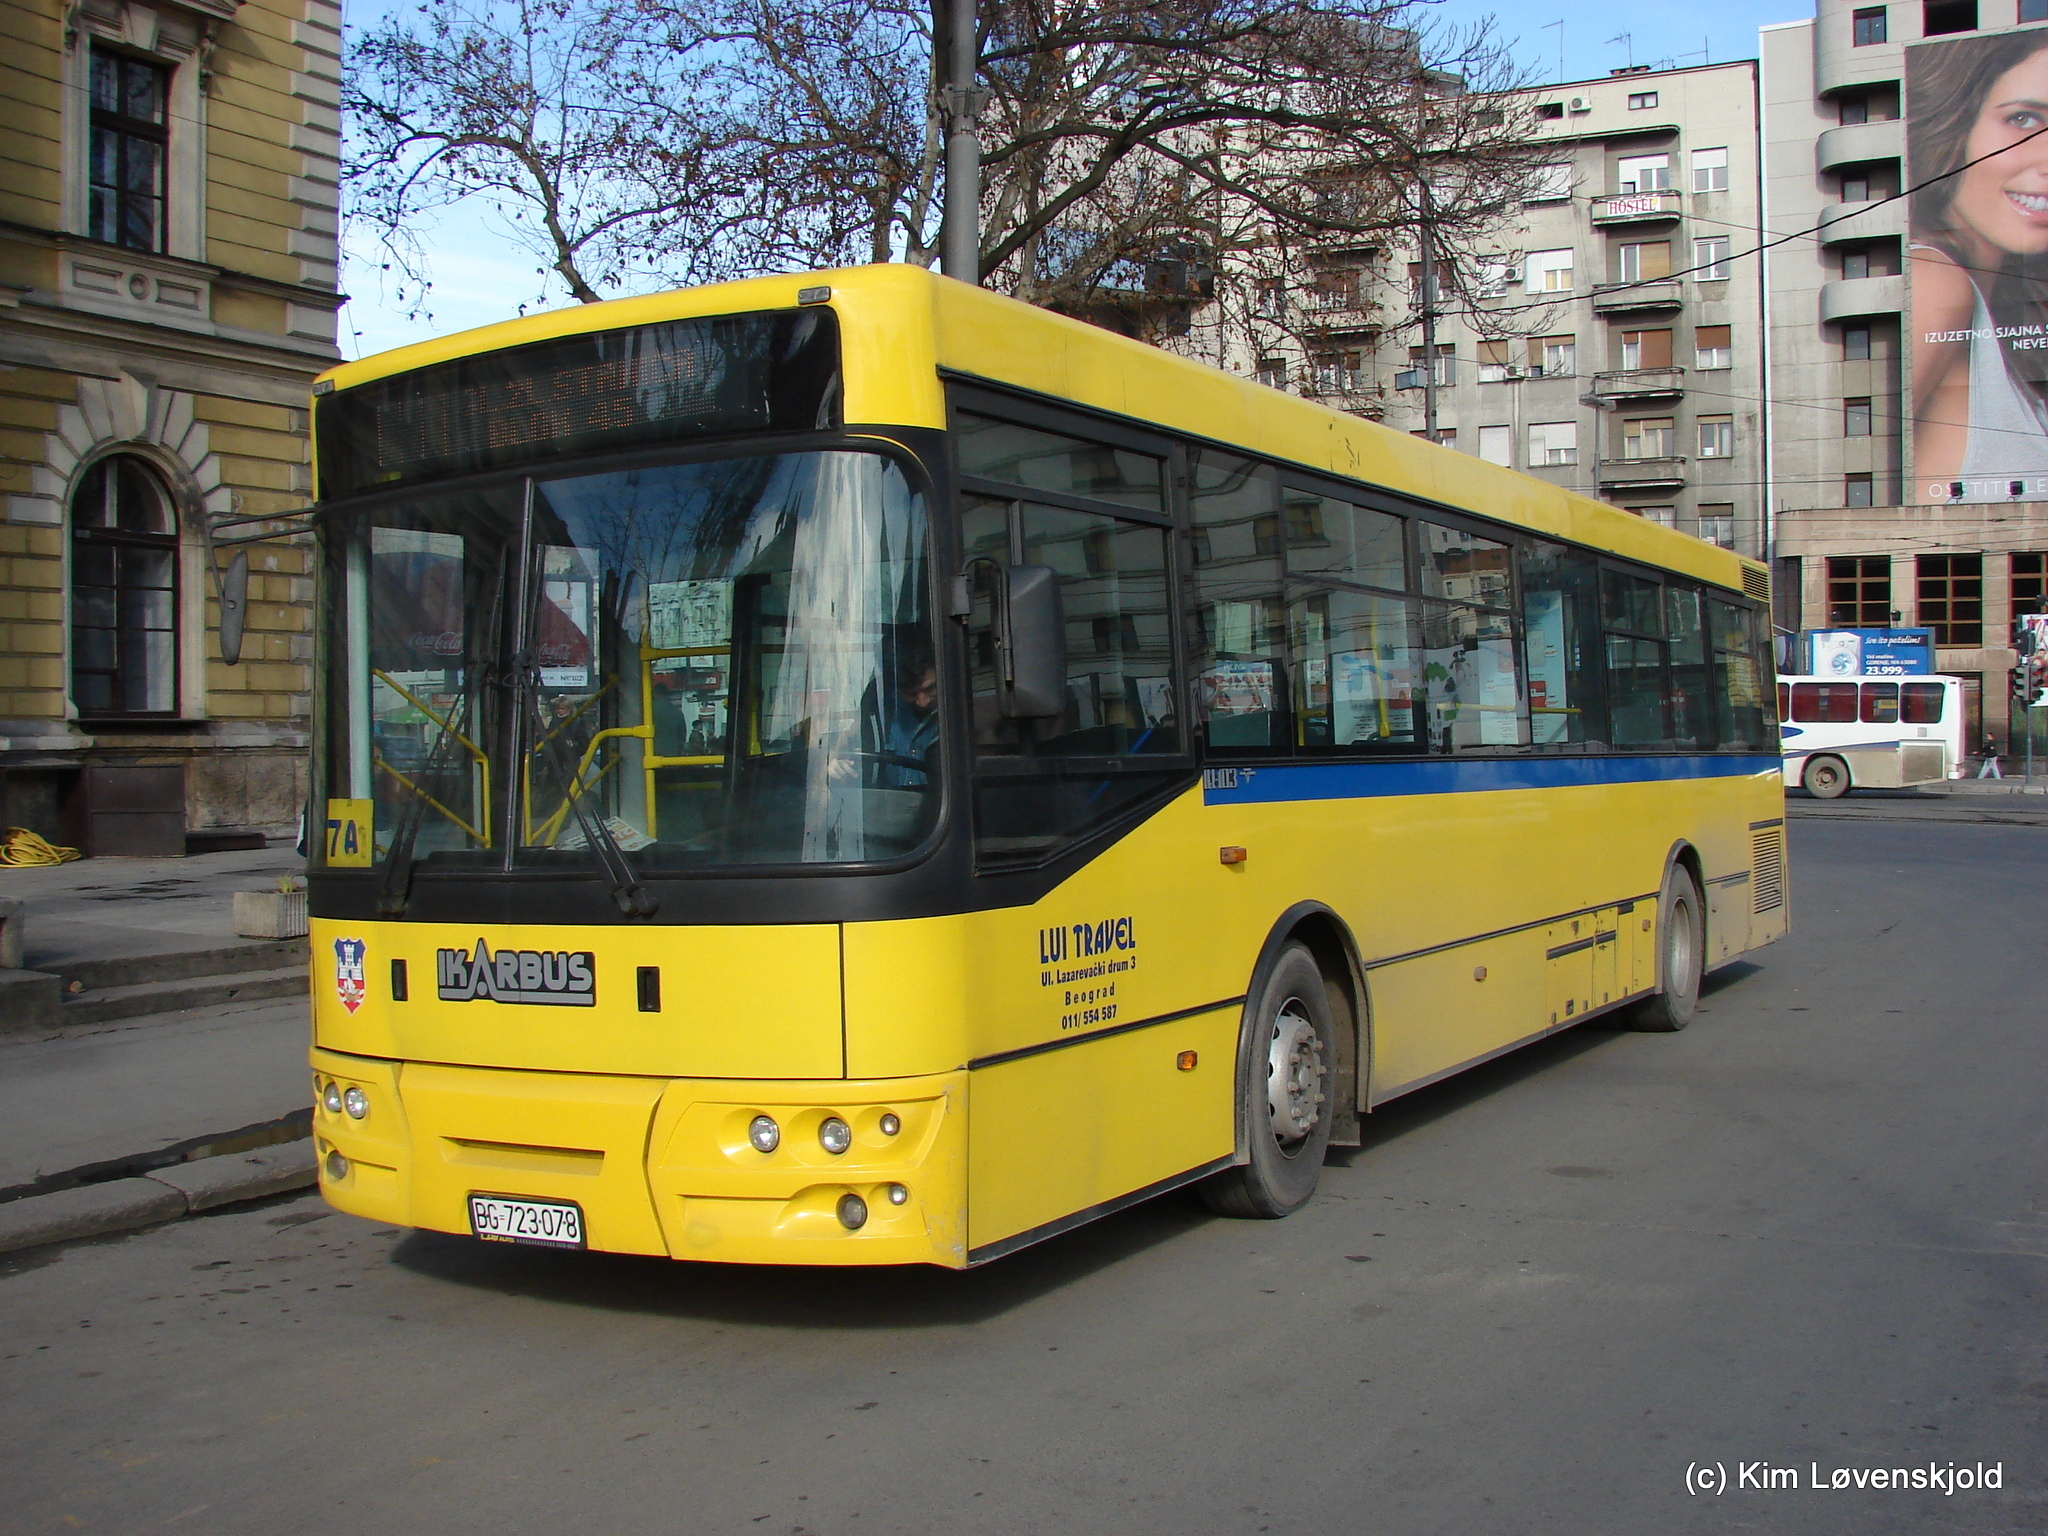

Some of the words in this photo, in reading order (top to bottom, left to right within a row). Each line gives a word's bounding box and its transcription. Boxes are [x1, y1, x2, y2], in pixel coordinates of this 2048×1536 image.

[1608, 198, 1656, 215] HOSTEL
[1925, 328, 1992, 343] IZUZETNO
[1995, 324, 2042, 338] SJAJNA
[2012, 337, 2048, 350] NEVE
[327, 818, 359, 858] 7A
[1039, 925, 1067, 964] LUI
[1072, 916, 1136, 958] TRAVEL
[437, 938, 595, 1002] IKARBUS
[1041, 970, 1054, 987] Ul.
[1107, 959, 1129, 974] drum
[1130, 955, 1136, 970] 3
[1061, 1012, 1081, 1030] 011/
[1083, 1008, 1099, 1025] 554
[1101, 1004, 1117, 1021] 587
